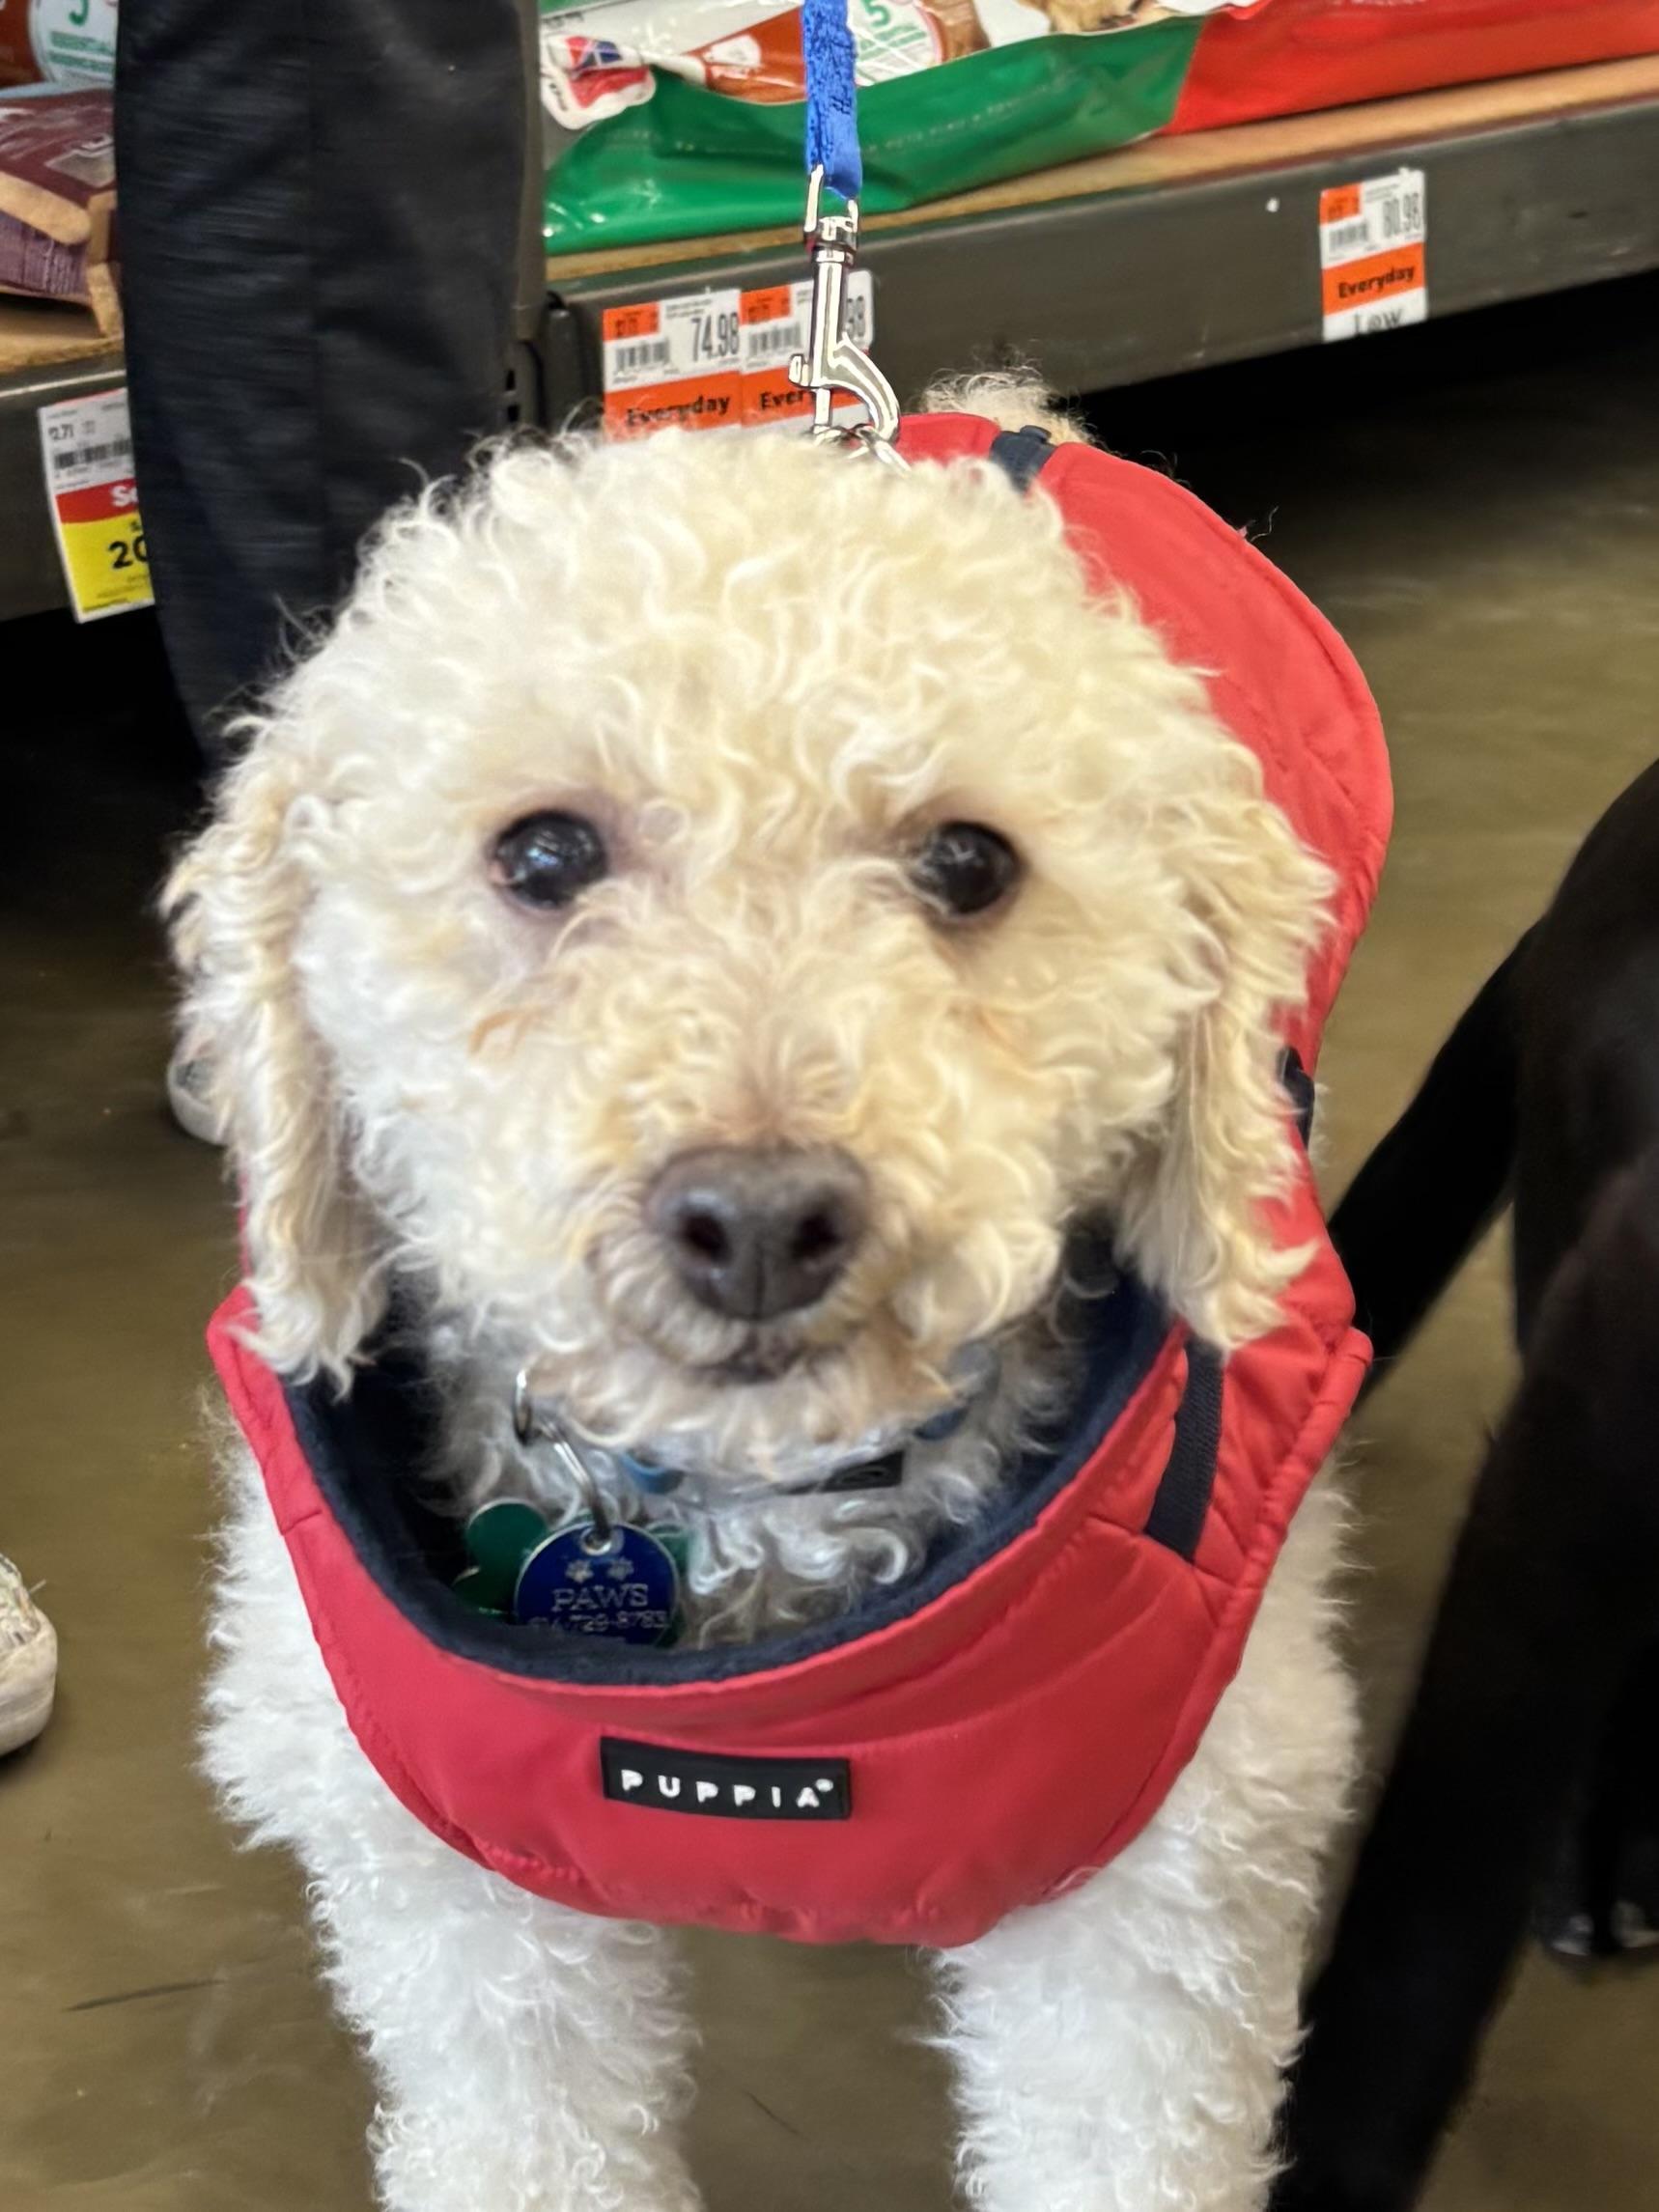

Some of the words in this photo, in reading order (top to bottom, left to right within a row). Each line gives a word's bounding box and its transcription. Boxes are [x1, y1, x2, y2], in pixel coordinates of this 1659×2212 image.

[1338, 266, 1415, 298] Everyday
[690, 312, 740, 361] 74.98
[551, 1582, 649, 1612] PAWS
[621, 1769, 820, 1807] PUPPIA
